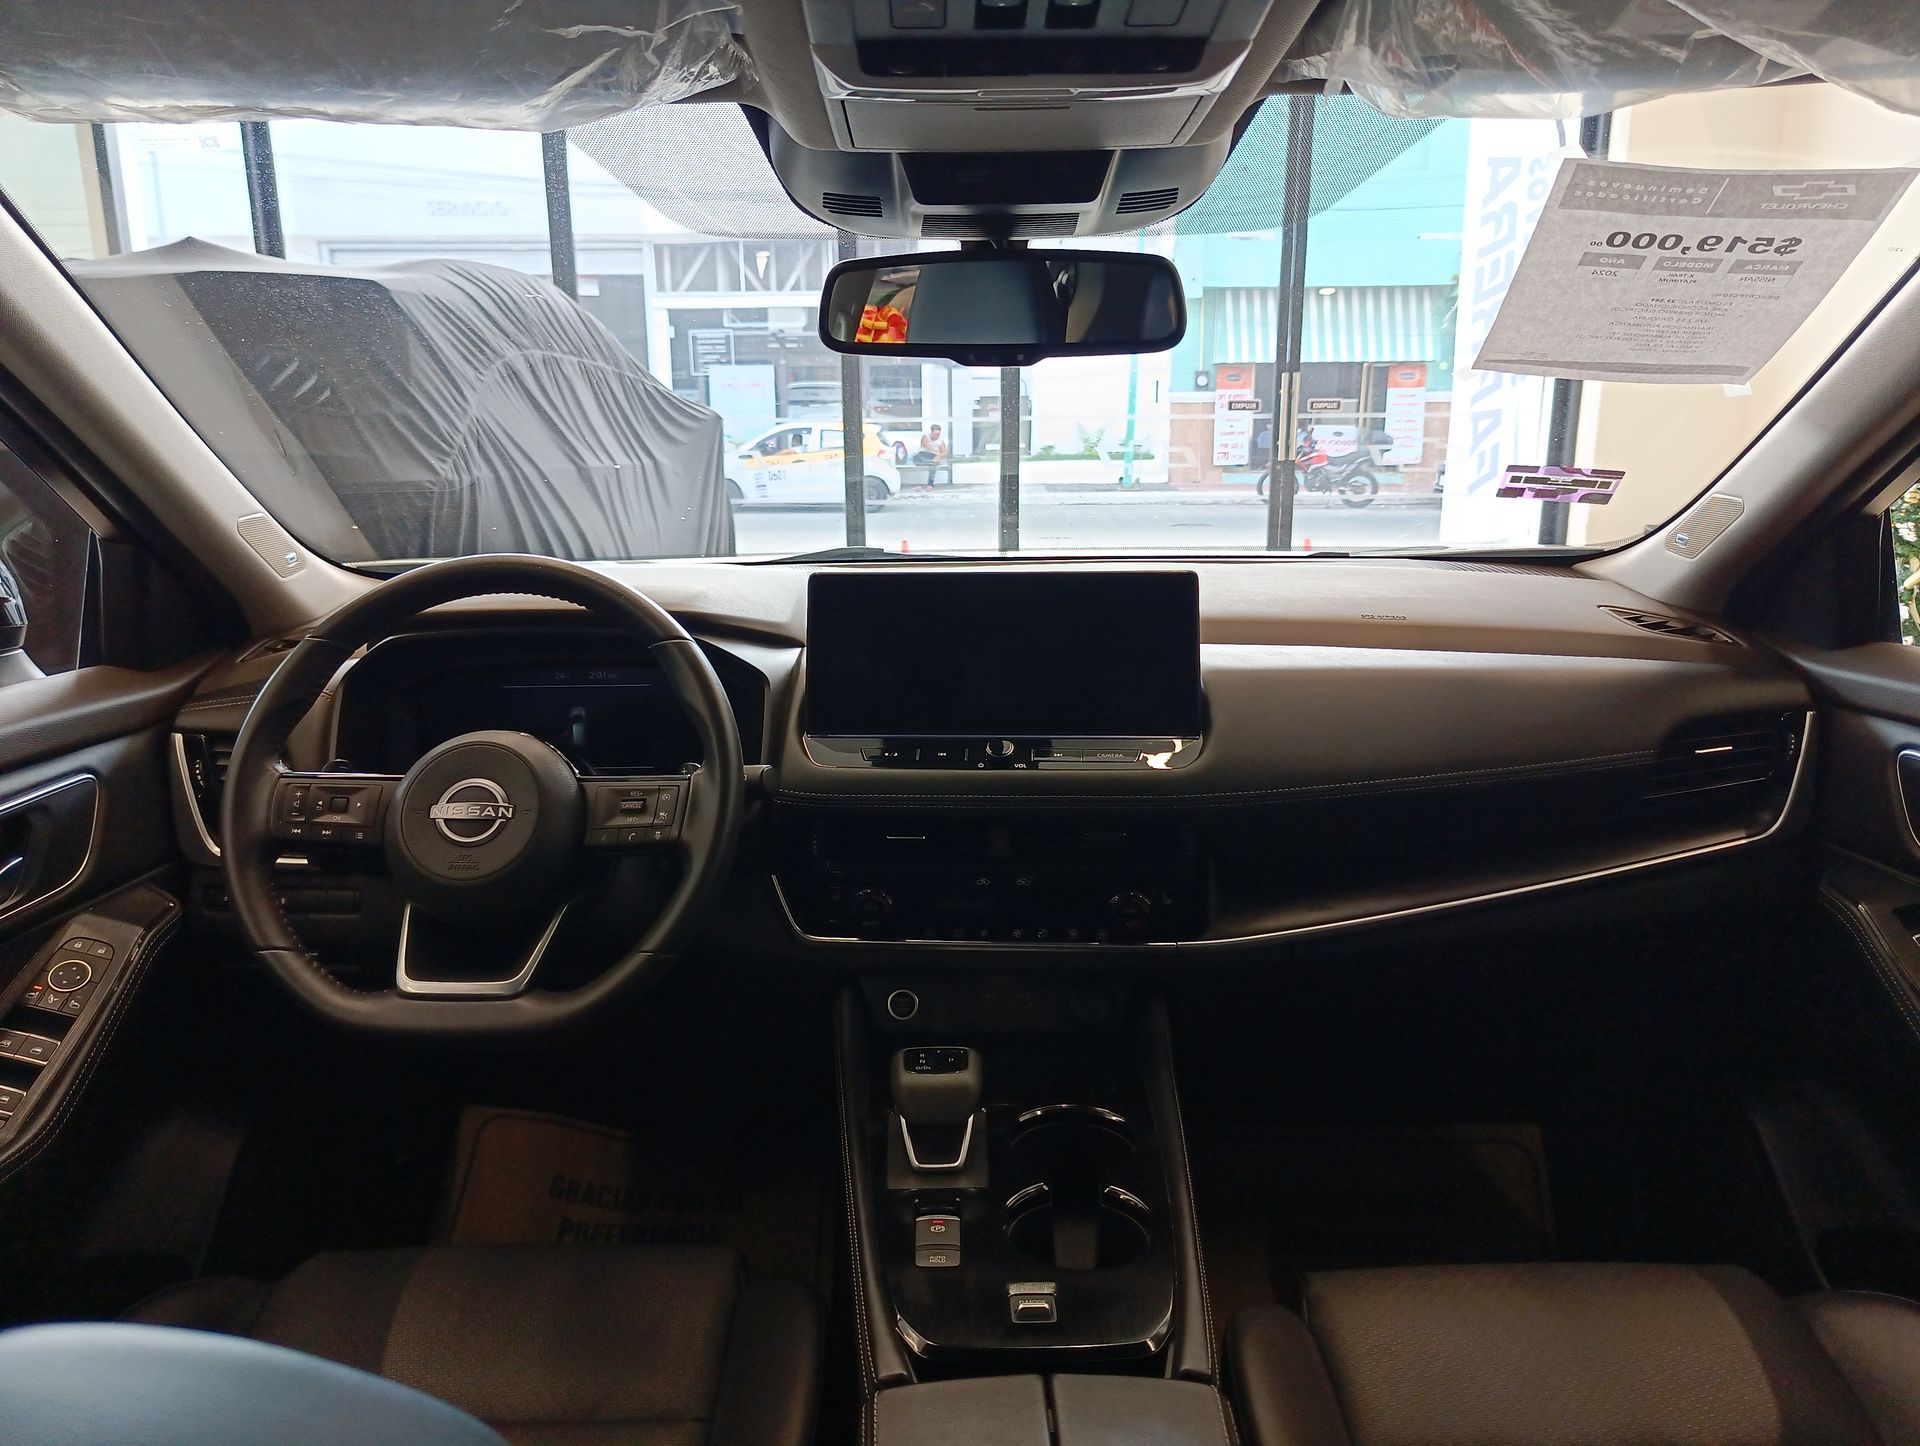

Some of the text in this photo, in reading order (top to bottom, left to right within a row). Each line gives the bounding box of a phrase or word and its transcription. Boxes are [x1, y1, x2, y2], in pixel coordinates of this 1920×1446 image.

[431, 805, 513, 818] NISSAN
[448, 864, 480, 872] AIRBAG
[548, 1171, 653, 1214] GRACIAS
[557, 1215, 723, 1245] PREFERENCIA
